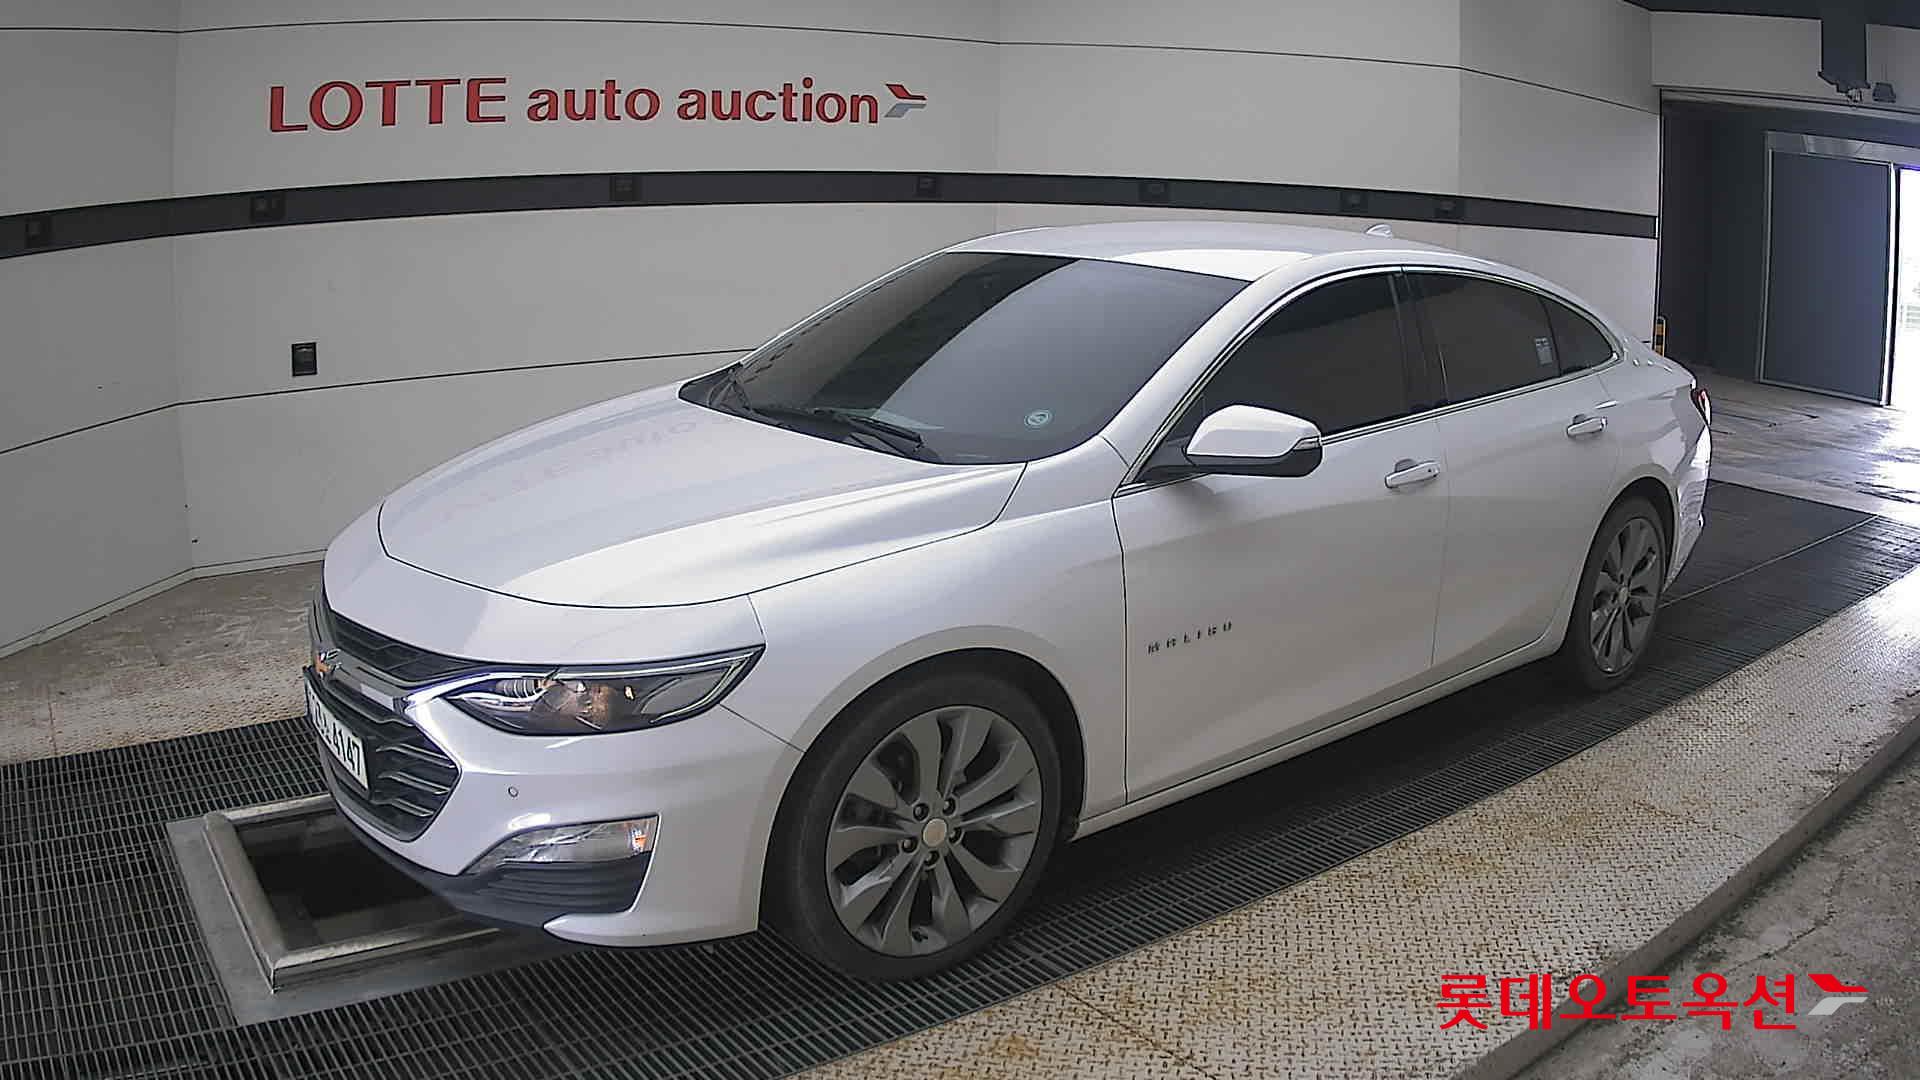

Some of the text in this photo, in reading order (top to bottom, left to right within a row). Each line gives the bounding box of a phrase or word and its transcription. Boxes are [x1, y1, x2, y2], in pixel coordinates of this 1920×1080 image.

[270, 77, 879, 133] LOTTE auto auction
[331, 722, 361, 777] 4147
